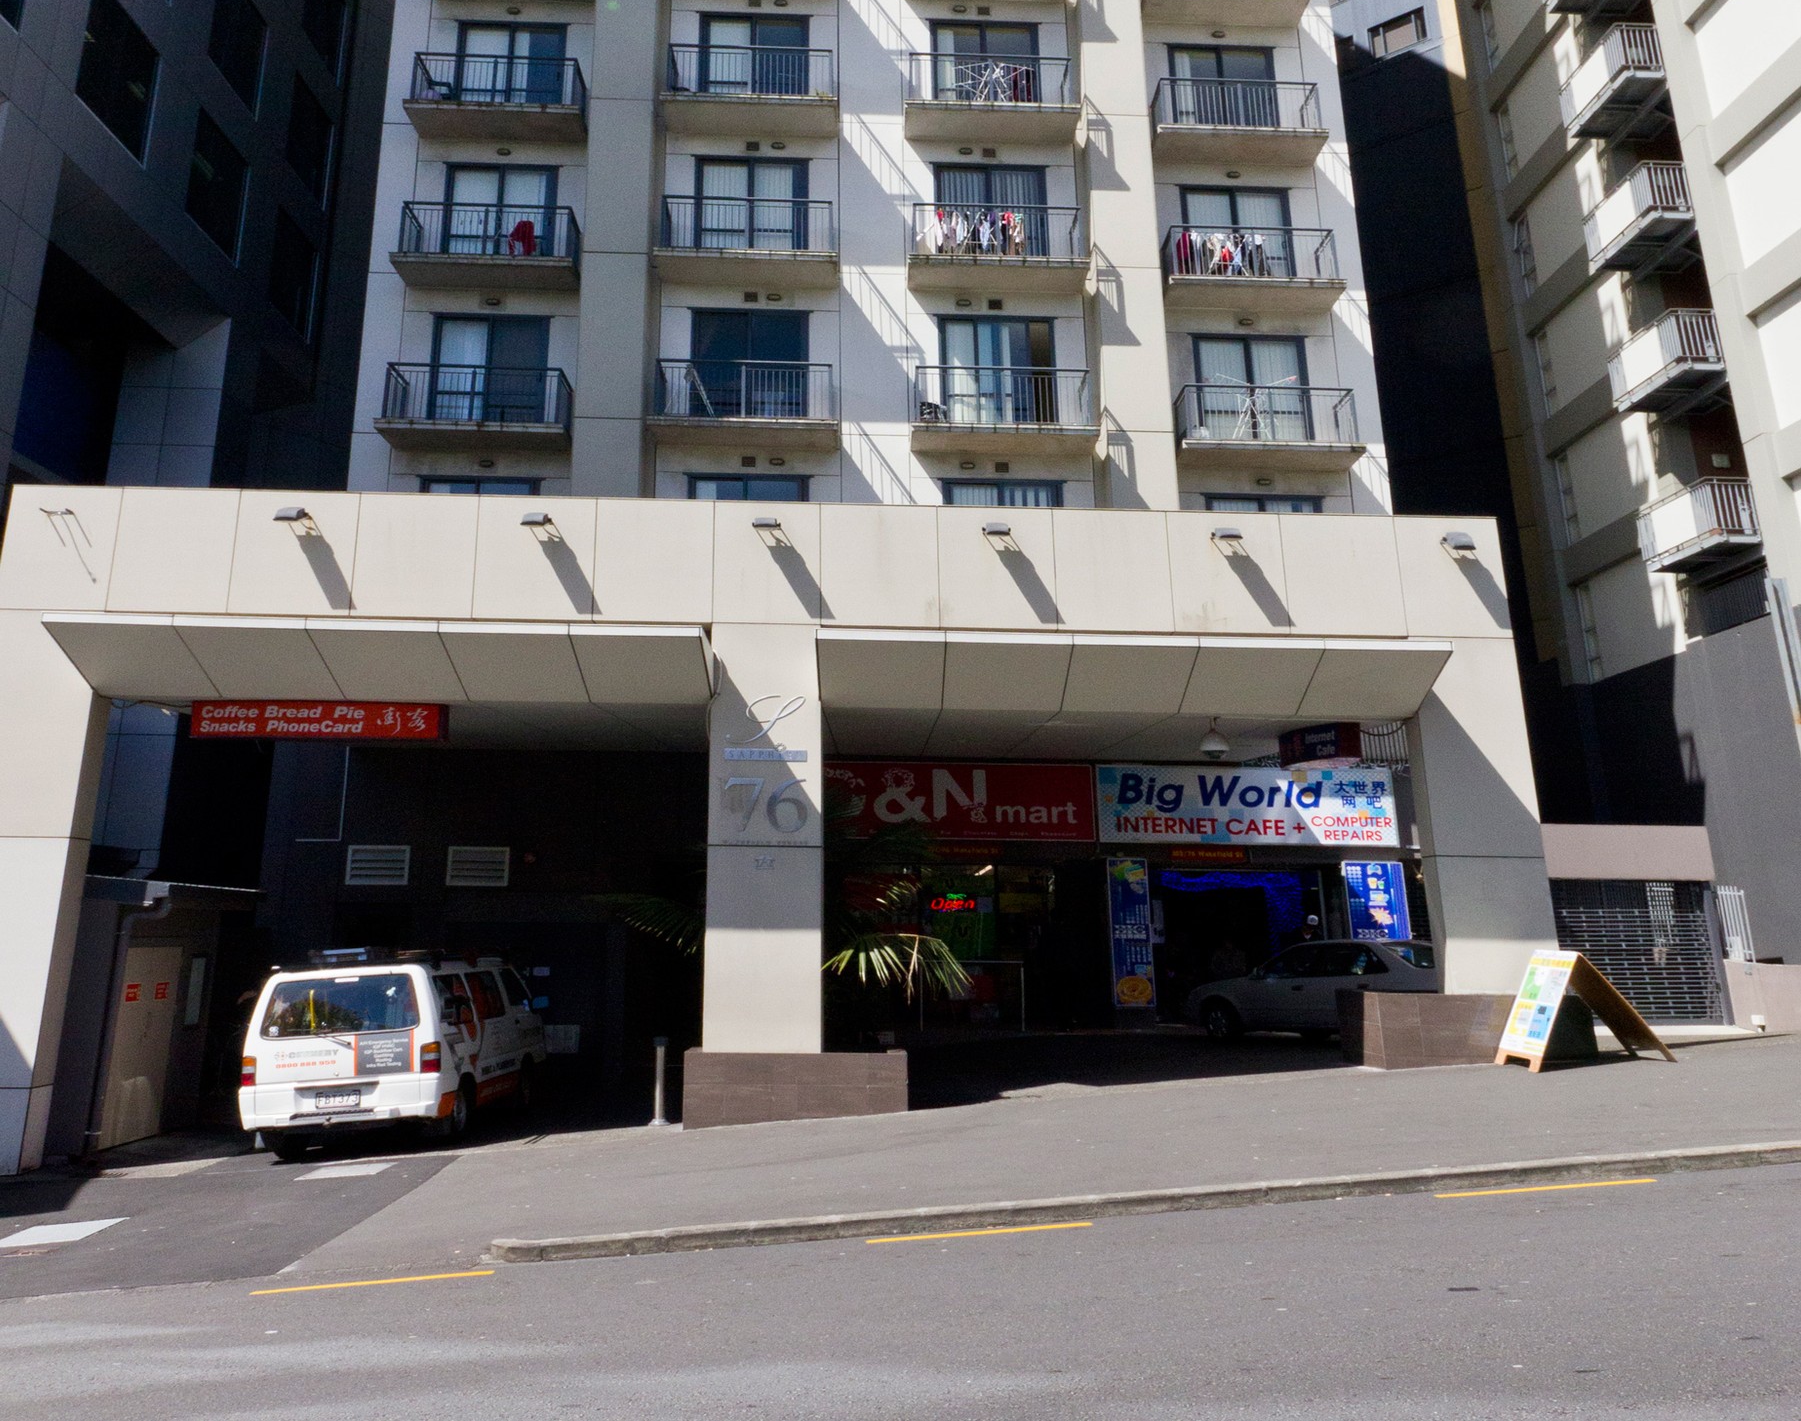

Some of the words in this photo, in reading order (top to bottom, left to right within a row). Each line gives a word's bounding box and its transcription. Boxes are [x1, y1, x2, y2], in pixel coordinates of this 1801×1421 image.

[200, 705, 260, 719] Coffee
[264, 705, 322, 719] Bread
[333, 706, 366, 719] Pie
[199, 720, 257, 733] Snacks
[265, 720, 364, 733] PhoneCard
[1304, 729, 1336, 745] Internet
[728, 750, 803, 760] SAPPHI
[1315, 743, 1336, 756] Cafe
[1116, 772, 1185, 813] Big
[1197, 774, 1324, 809] World
[1334, 780, 1388, 795] 大世界
[724, 776, 808, 833] 76
[1341, 795, 1383, 809] 网吧
[995, 802, 1078, 824] mart
[1115, 816, 1220, 834] INTERNET
[1225, 818, 1286, 836] CAFE
[1310, 815, 1393, 828] COMPUTER
[1323, 829, 1383, 842] REPAIRS
[930, 897, 976, 911] Open
[318, 1092, 359, 1105] FBT373
